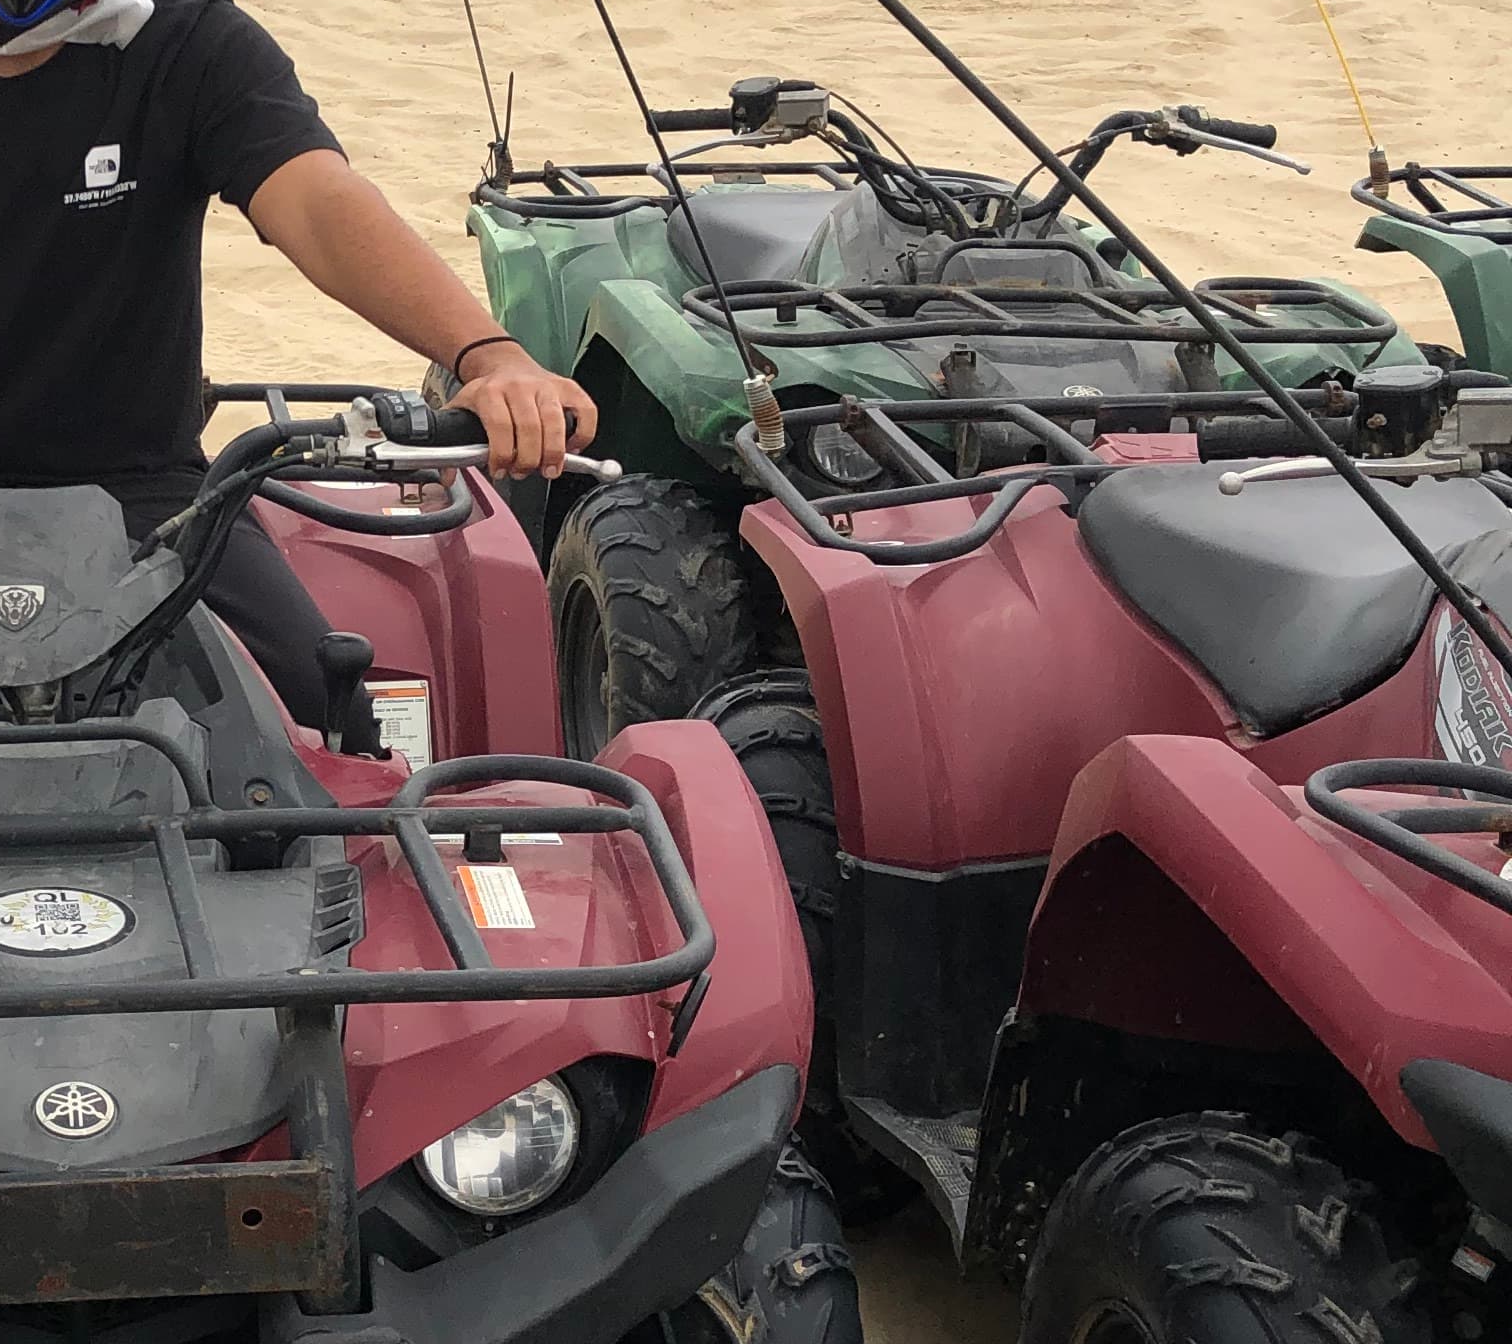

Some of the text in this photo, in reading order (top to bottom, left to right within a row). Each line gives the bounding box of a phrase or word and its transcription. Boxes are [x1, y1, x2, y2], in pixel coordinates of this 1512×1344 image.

[1447, 618, 1512, 758] KODIAK
[1455, 707, 1487, 766] 450
[33, 892, 79, 903] QL
